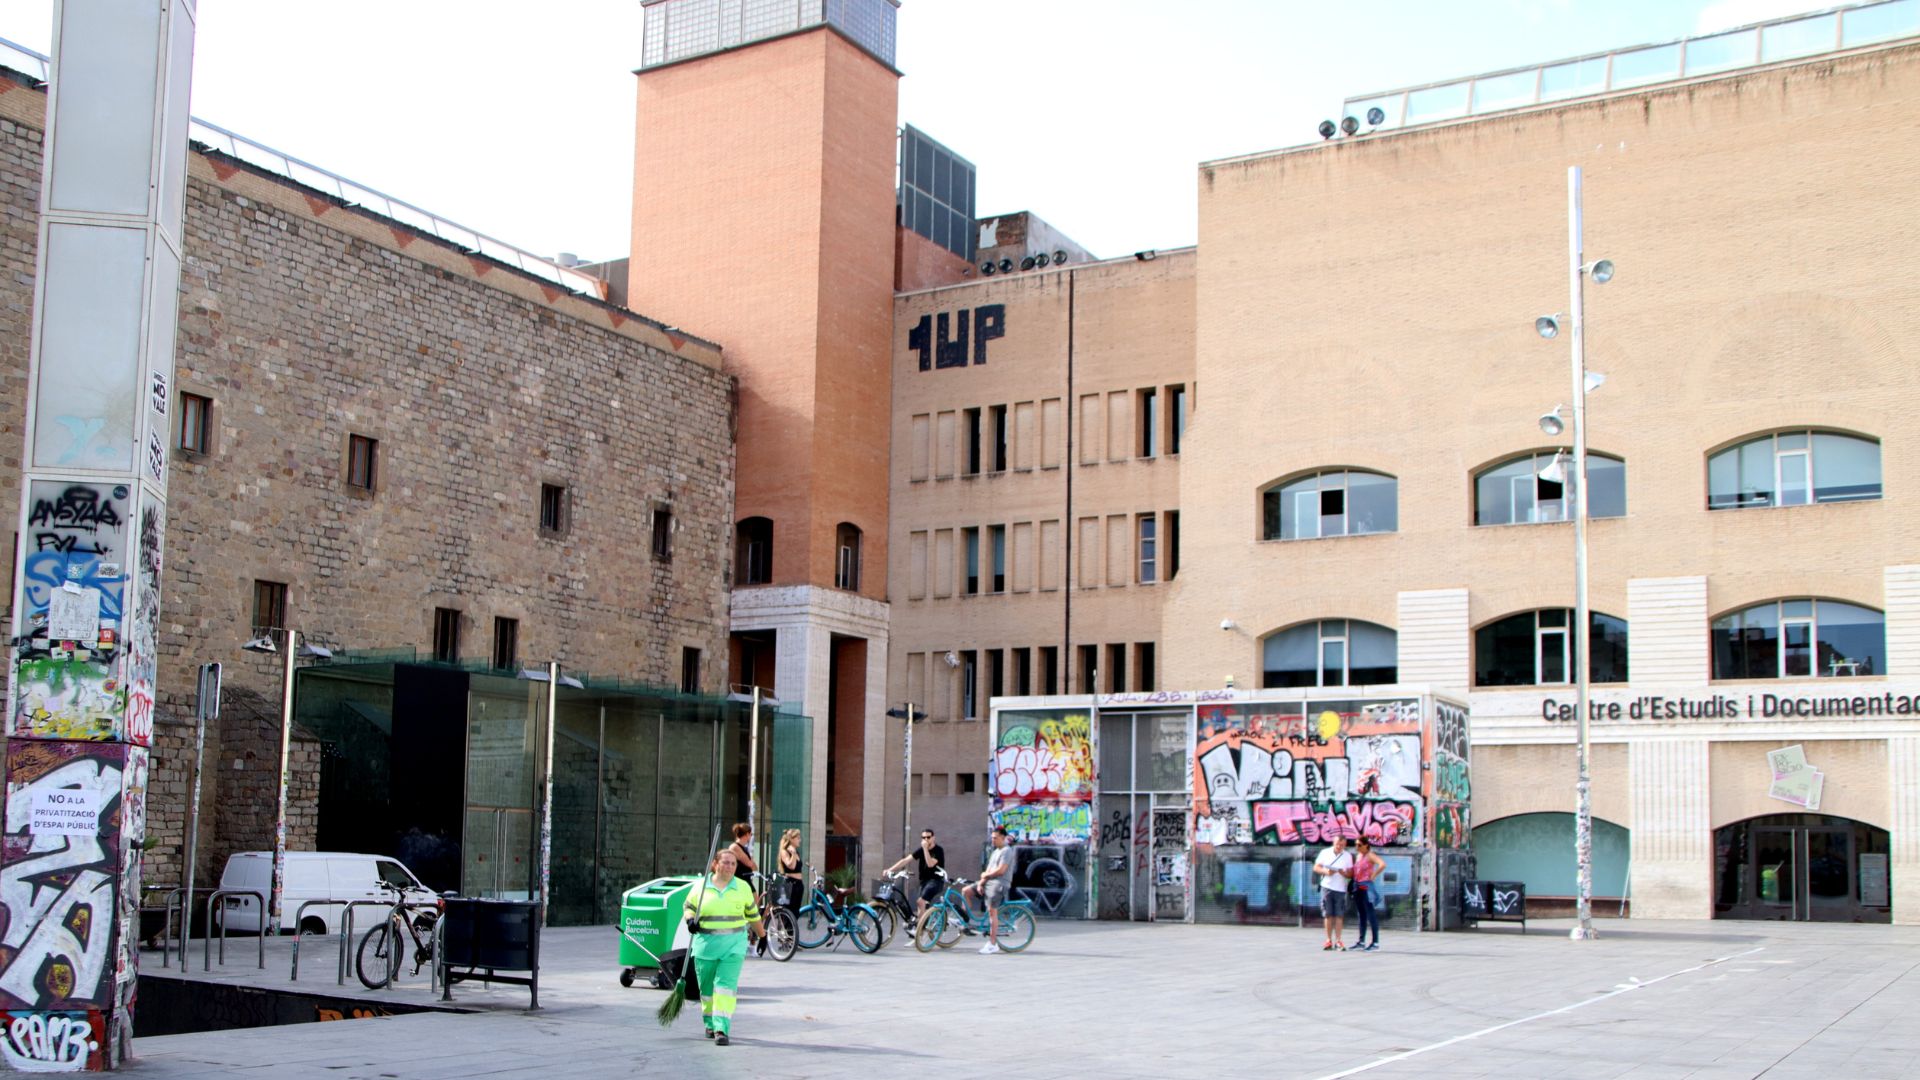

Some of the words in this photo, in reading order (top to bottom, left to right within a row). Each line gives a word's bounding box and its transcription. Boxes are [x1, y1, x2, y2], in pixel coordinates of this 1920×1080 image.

[909, 304, 1006, 373] 1UP
[1748, 695, 1753, 718] i
[48, 794, 65, 804] NO
[75, 797, 85, 805] LA
[35, 809, 96, 818] PRIVATITZACIÓ
[66, 820, 96, 830] PÚBLIC
[625, 925, 660, 935] Barcelona
